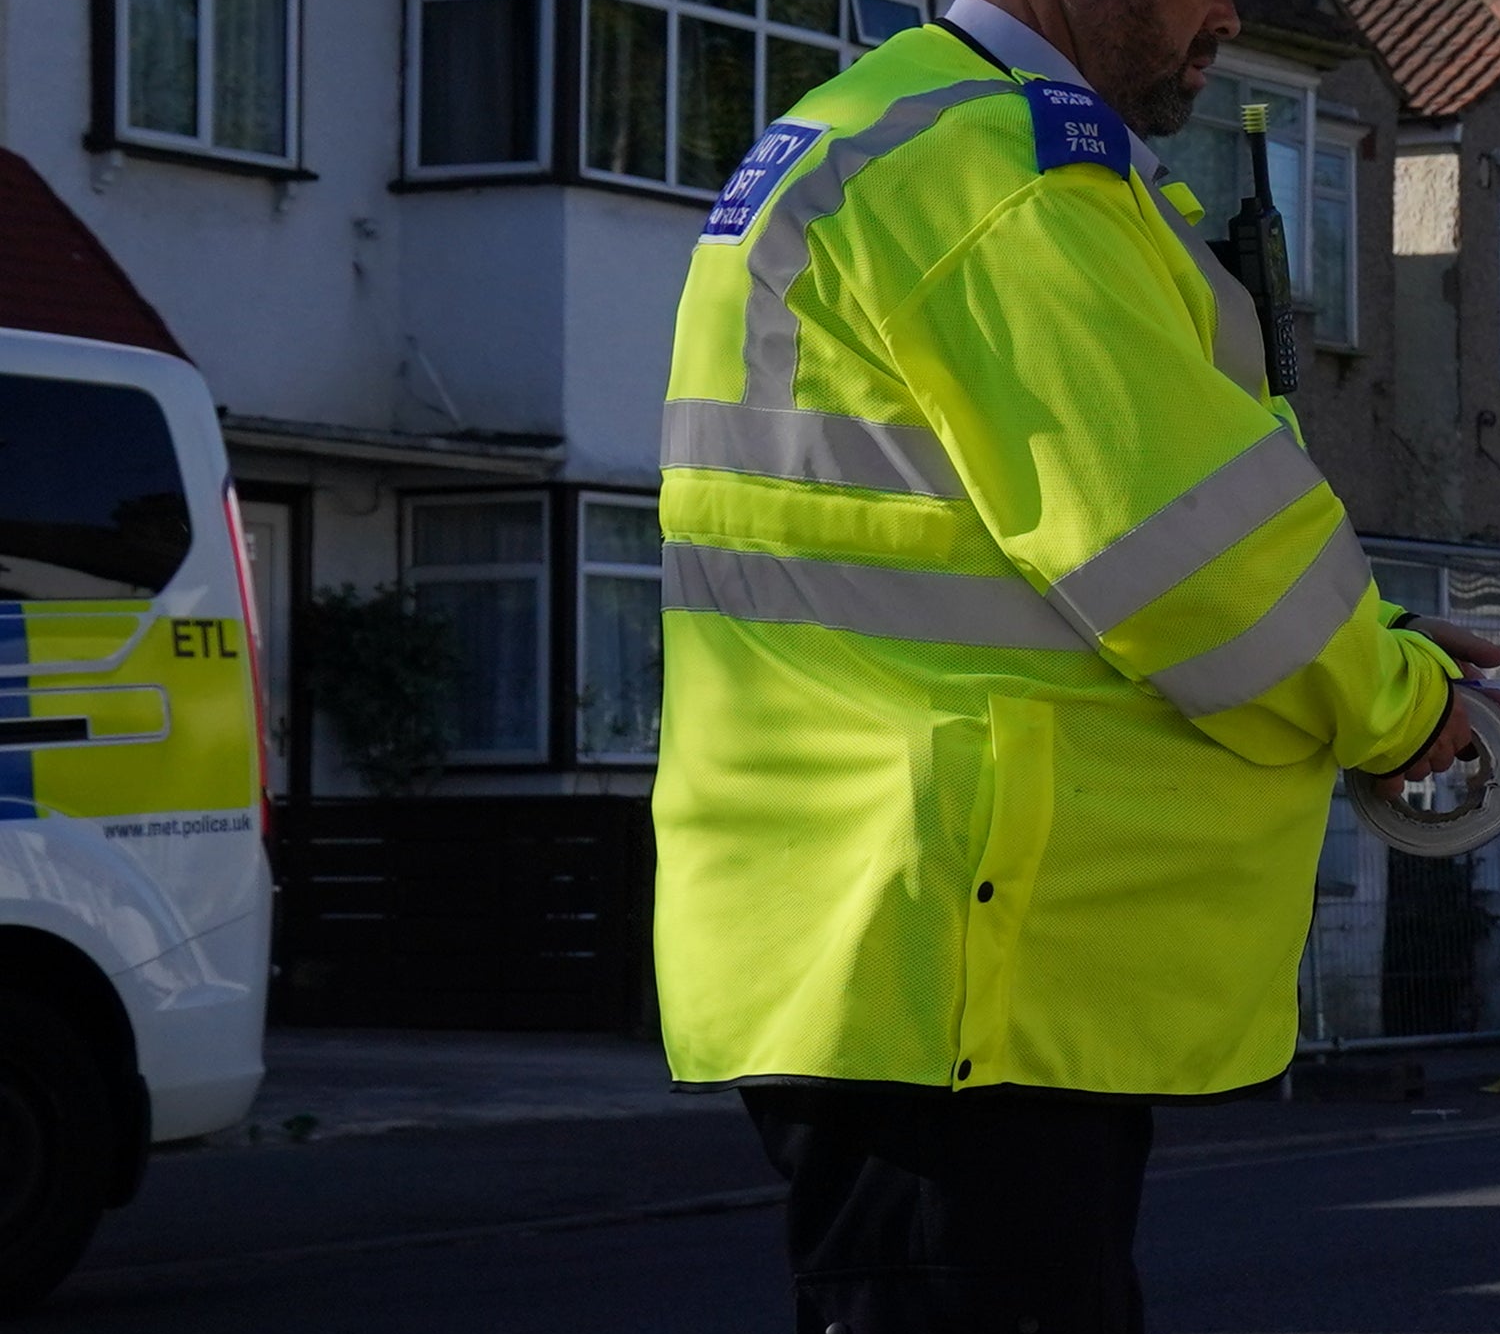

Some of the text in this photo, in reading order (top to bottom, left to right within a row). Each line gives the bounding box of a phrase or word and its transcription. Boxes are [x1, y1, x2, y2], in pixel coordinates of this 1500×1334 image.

[1065, 121, 1098, 137] SW
[1066, 137, 1106, 155] 7131
[171, 619, 238, 658] ETL
[102, 814, 253, 840] www.met.police.uk
